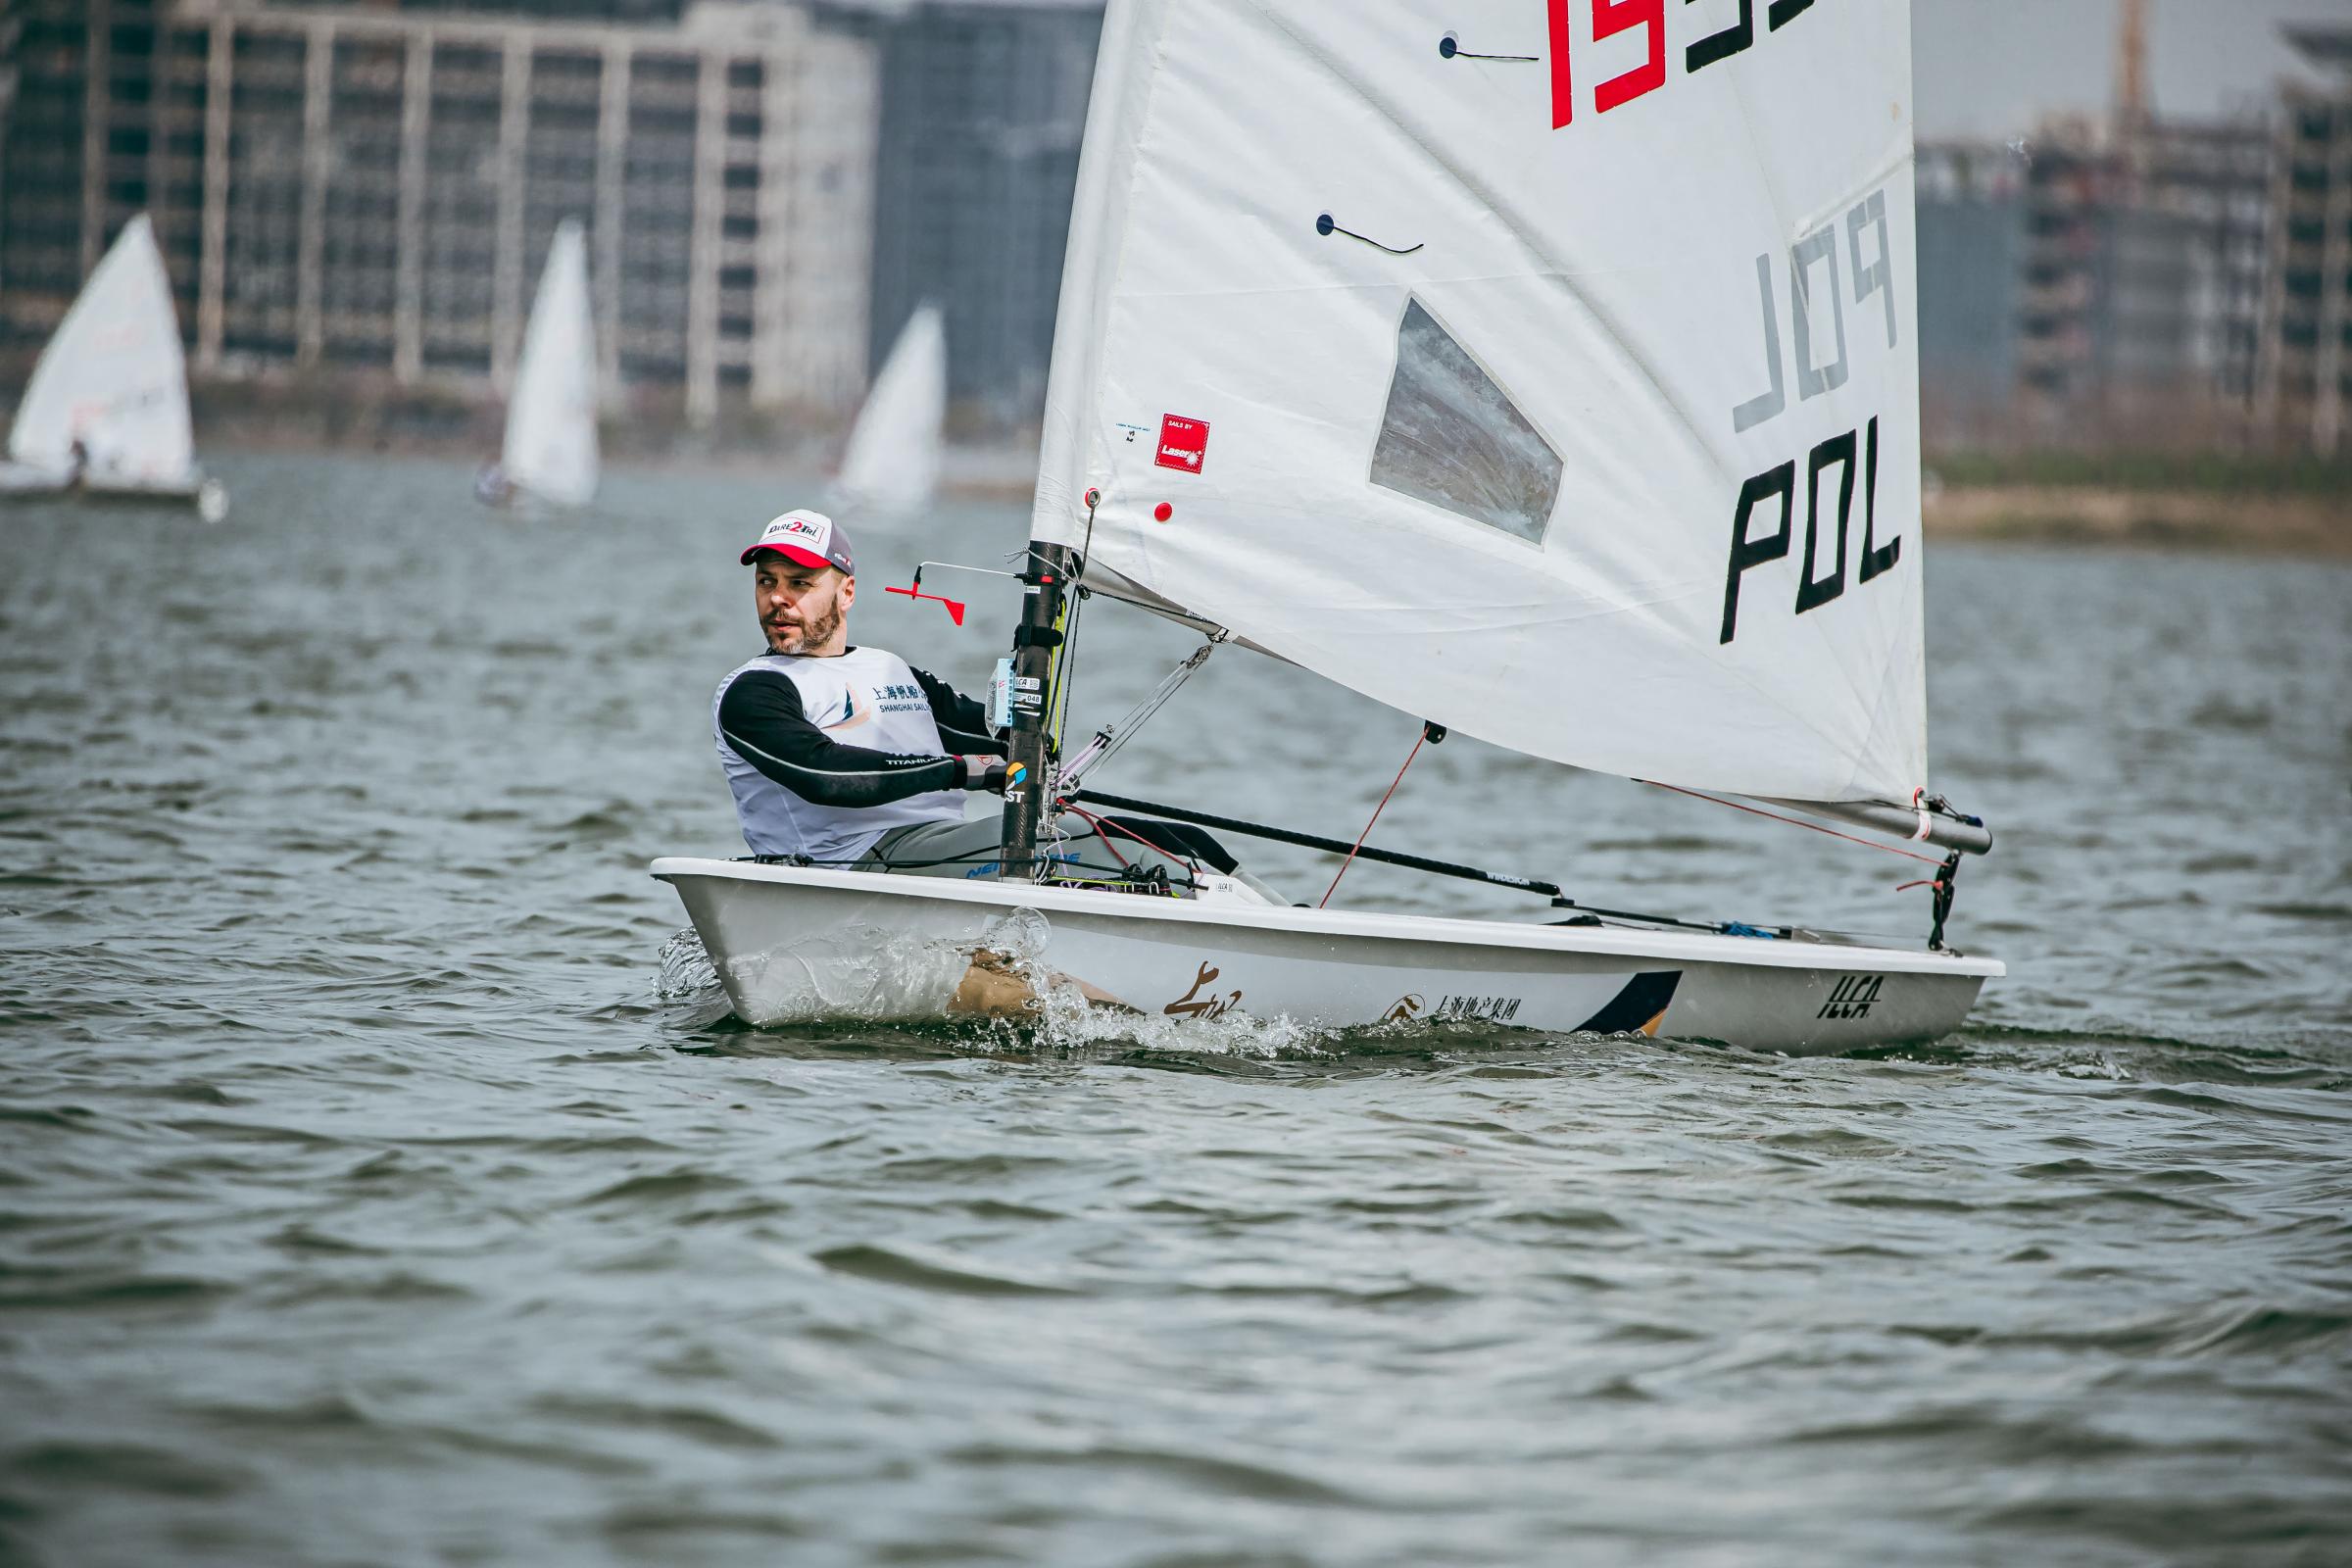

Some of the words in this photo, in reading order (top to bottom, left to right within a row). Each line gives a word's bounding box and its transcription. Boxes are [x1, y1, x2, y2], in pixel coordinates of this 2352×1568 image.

[1161, 445, 1189, 459] Laser
[1719, 415, 1901, 645] POL
[879, 704, 913, 713] SHANGHAI
[1436, 995, 1521, 1020] 上海地产集团
[1816, 975, 1884, 1019] ILCA
